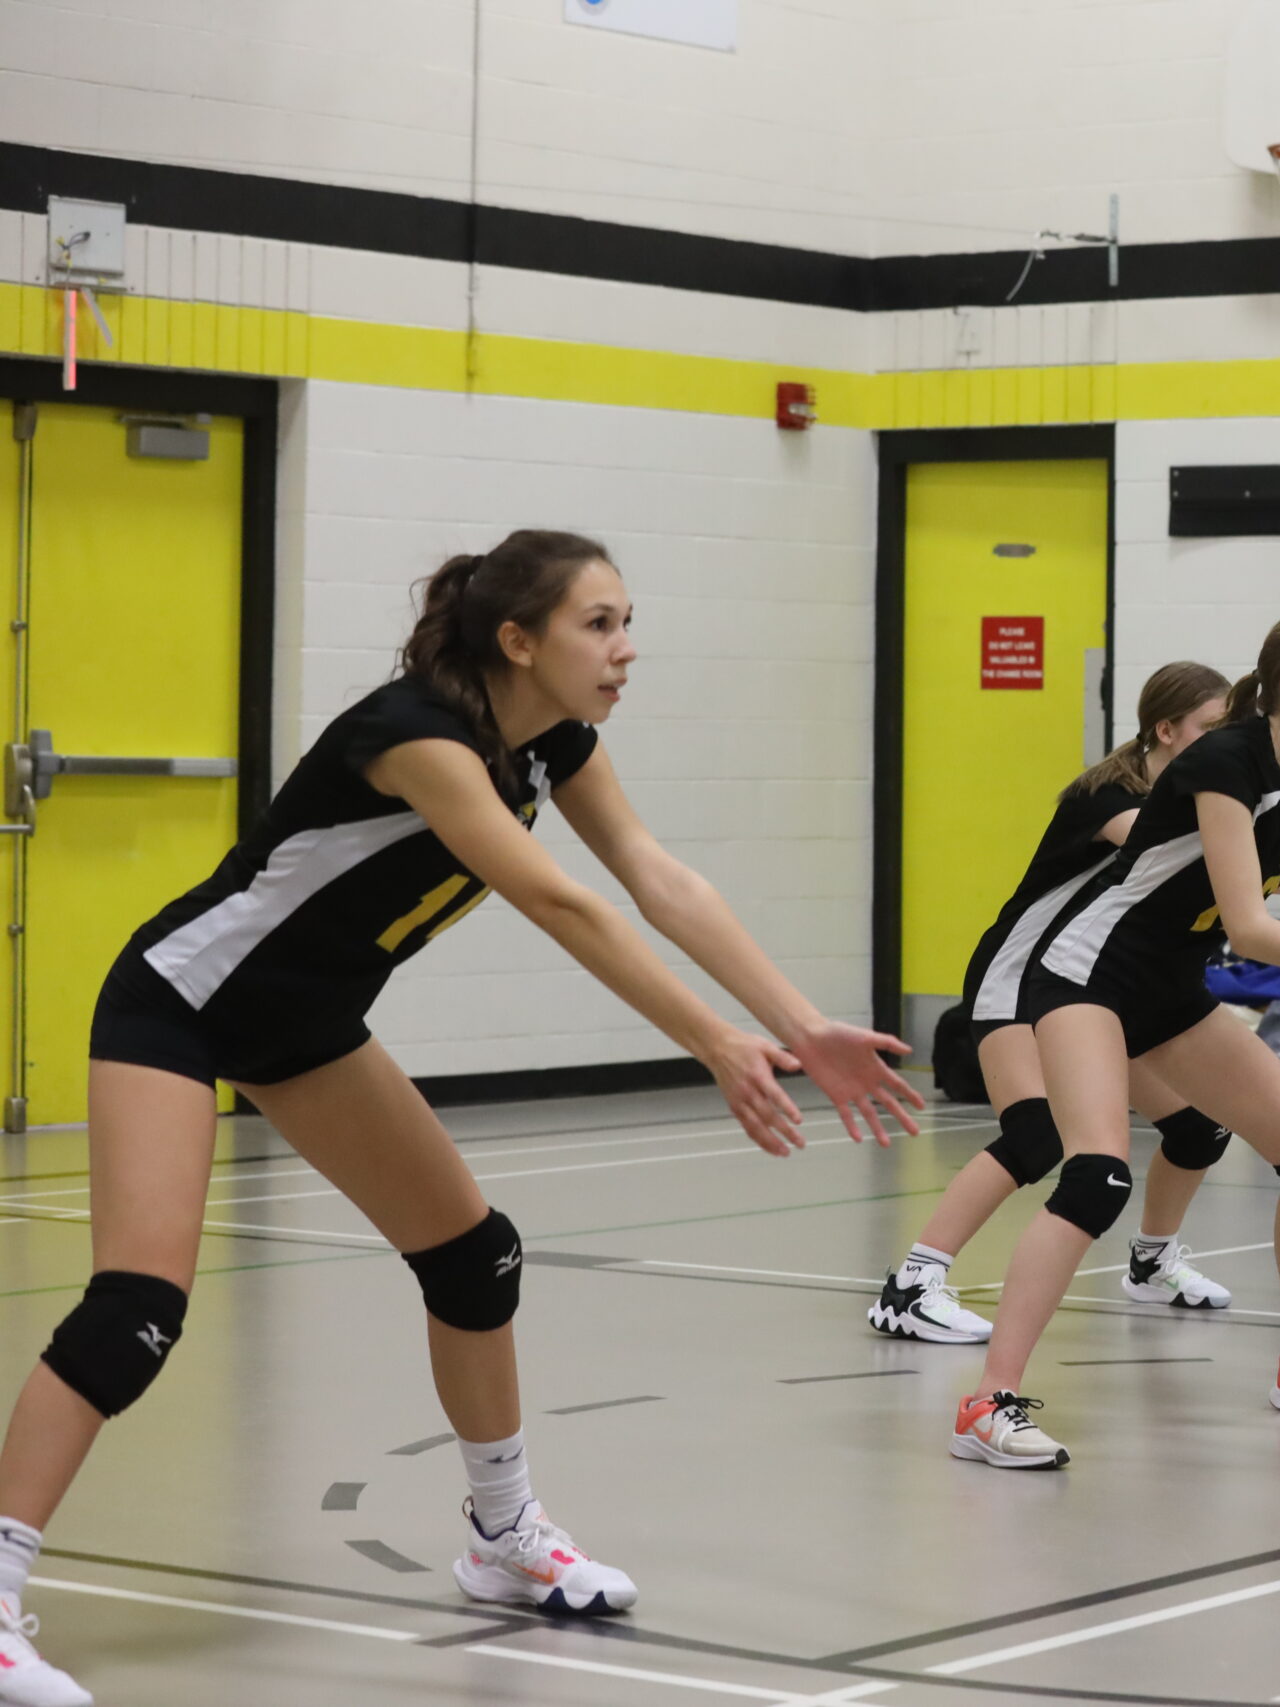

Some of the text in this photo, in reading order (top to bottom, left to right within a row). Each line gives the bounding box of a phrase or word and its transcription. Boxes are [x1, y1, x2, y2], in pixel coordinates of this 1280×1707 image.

[999, 627, 1025, 637] PLEASE
[988, 641, 1036, 651] DO NOT LEAVE
[989, 655, 1027, 664] VALUABLES
[982, 669, 1043, 679] THE CHANGE ROOM
